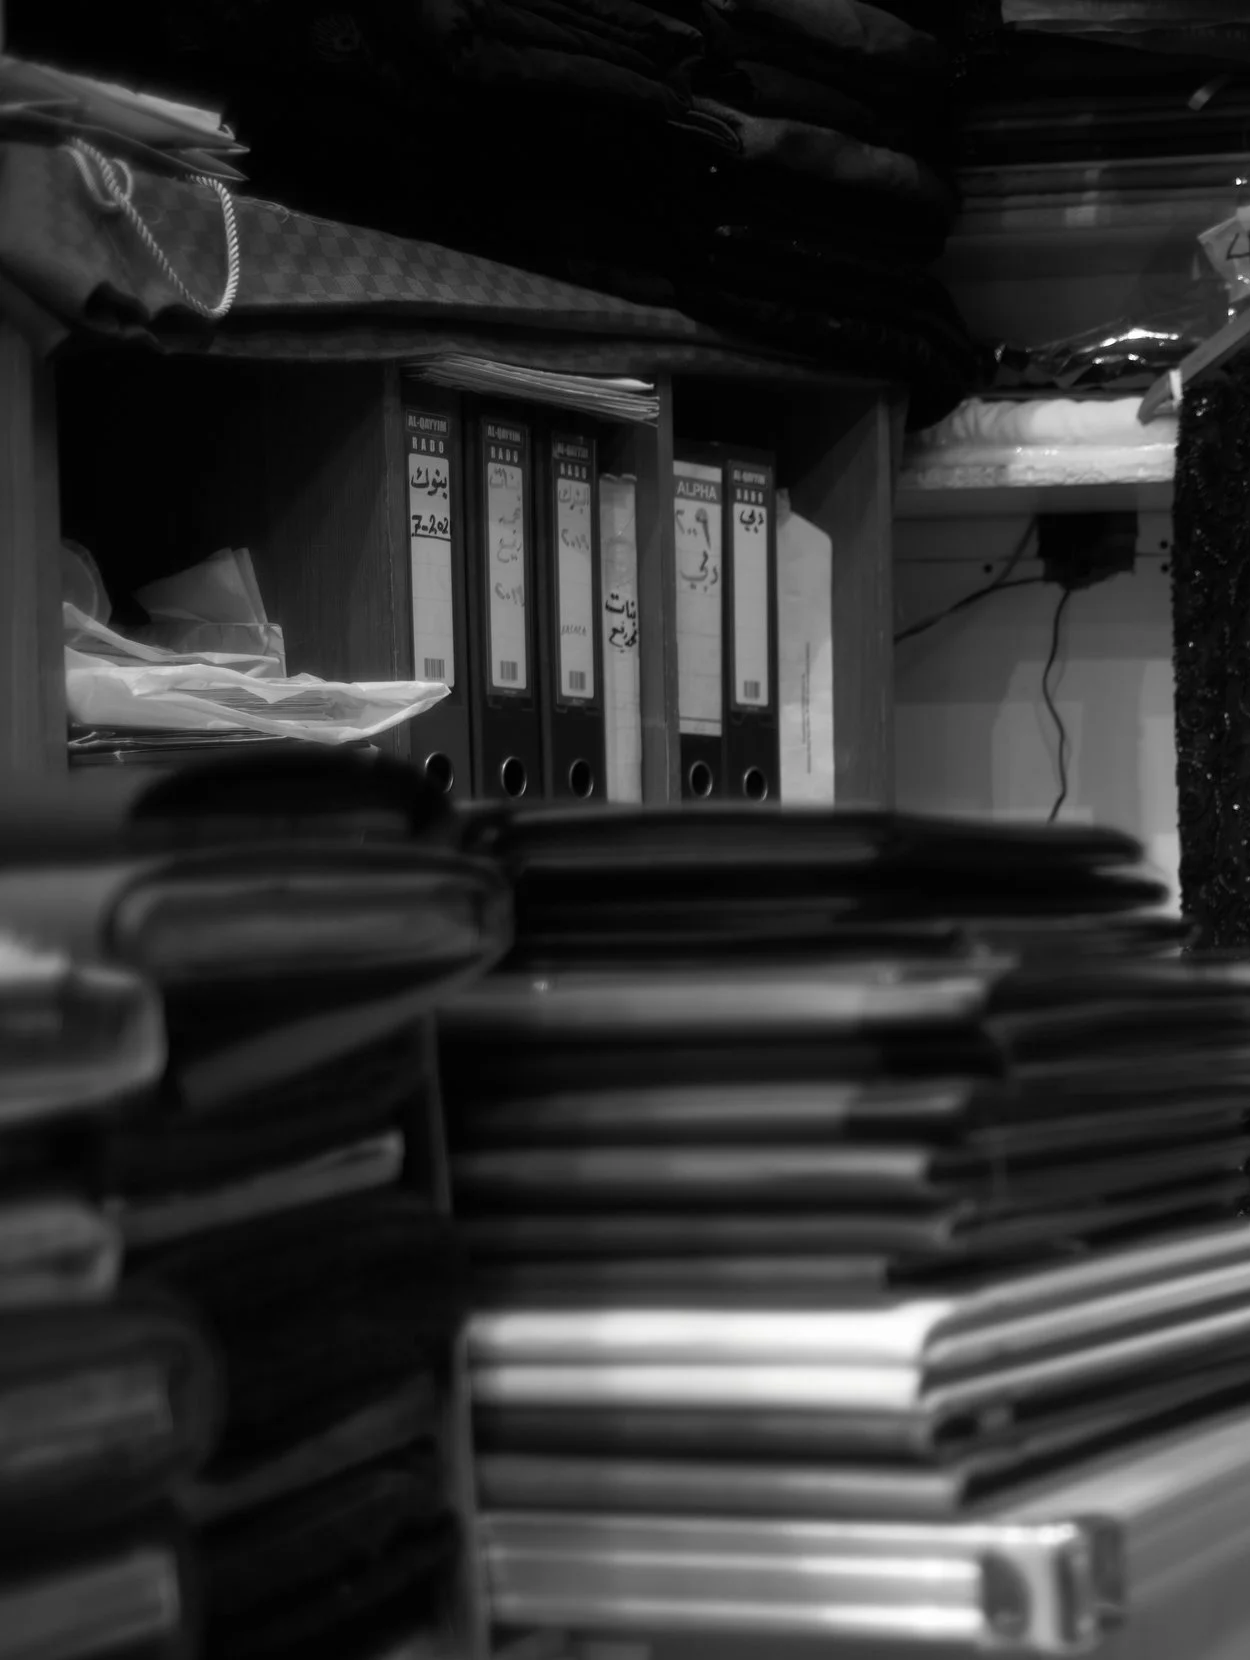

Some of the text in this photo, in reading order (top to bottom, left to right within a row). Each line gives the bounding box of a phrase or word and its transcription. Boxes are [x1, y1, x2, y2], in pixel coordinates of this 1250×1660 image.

[408, 415, 447, 433] AL-QAYYIM
[412, 436, 444, 453] RADO
[490, 446, 519, 463] RADO
[410, 466, 448, 499] بنوك
[676, 480, 717, 501] ALPHA
[739, 509, 765, 534] دبي
